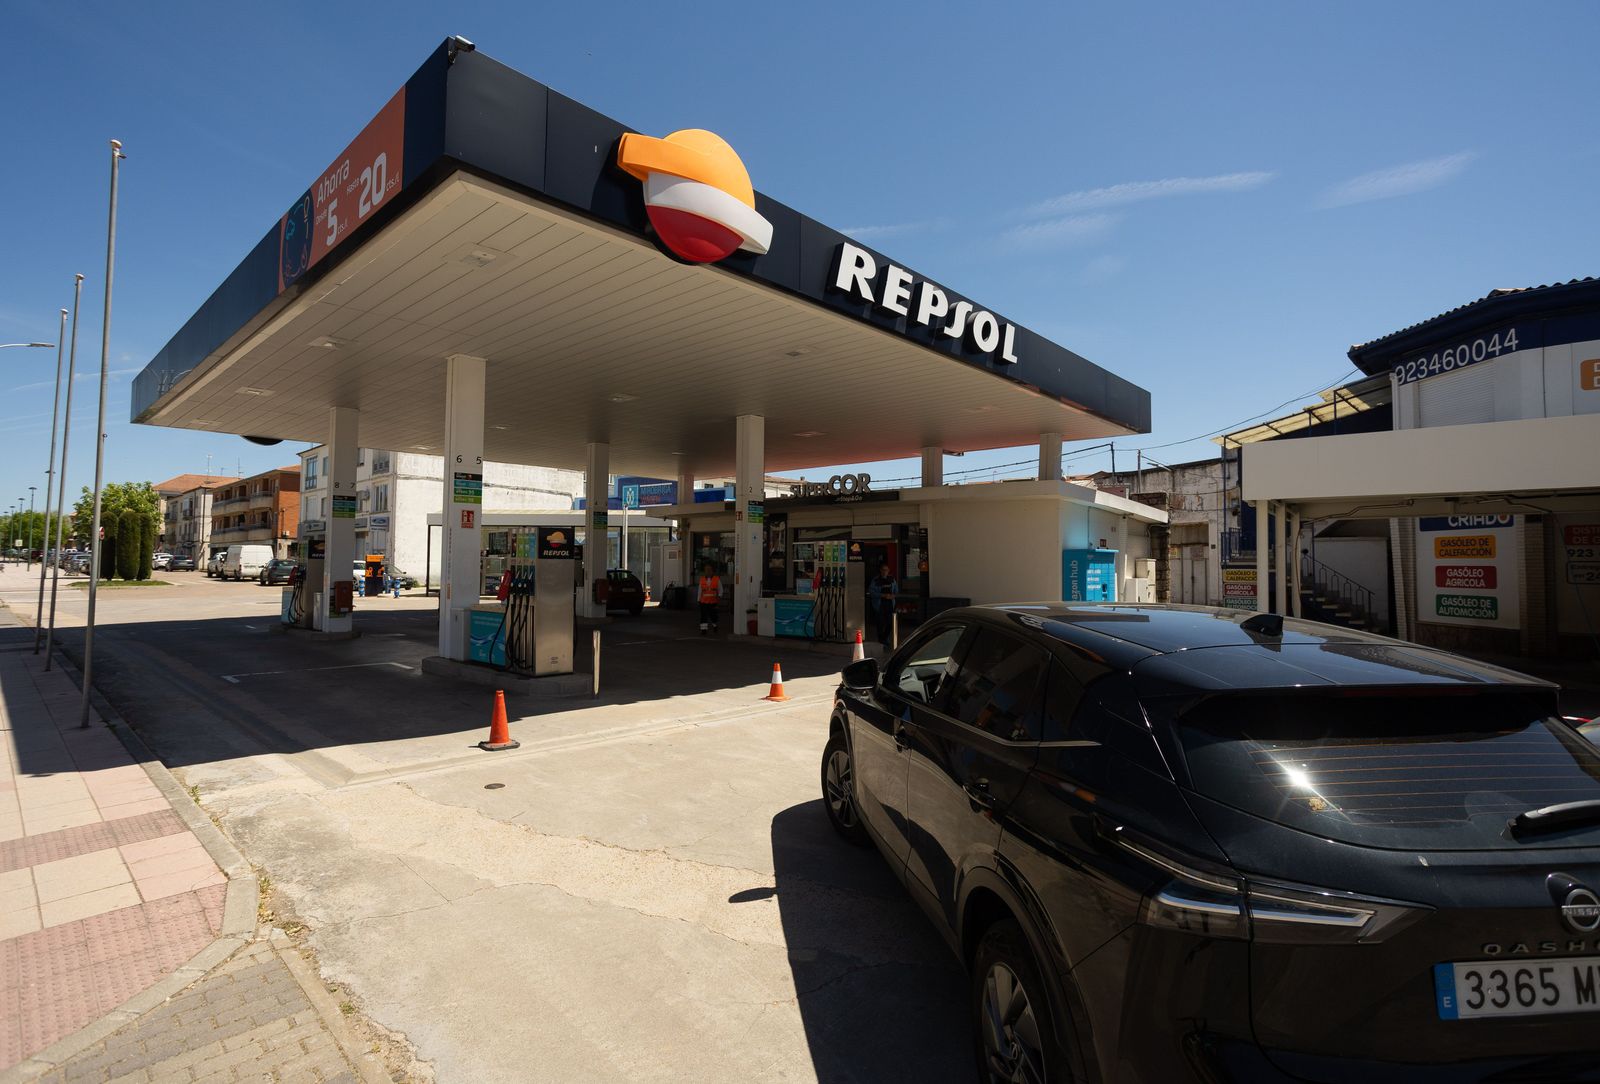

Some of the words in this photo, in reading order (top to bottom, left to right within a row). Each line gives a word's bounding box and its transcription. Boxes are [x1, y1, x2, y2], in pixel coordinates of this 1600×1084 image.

[316, 159, 350, 208] Ahorra
[358, 151, 387, 219] 20
[326, 198, 338, 247] 5
[835, 241, 1018, 364] REPSOL
[1395, 328, 1519, 385] 923460044
[456, 454, 463, 464] 6
[475, 456, 482, 465] 5
[334, 481, 340, 489] 8
[1447, 514, 1510, 528] CRIADO
[1440, 537, 1475, 547] GASÓLEO
[1478, 537, 1489, 547] DE
[1572, 536, 1590, 544] DE
[543, 549, 570, 557] REPSOL
[1567, 548, 1594, 558] 923
[1069, 560, 1079, 578] hub
[1446, 567, 1485, 578] GASÓLEO
[1071, 581, 1079, 601] azon
[1440, 597, 1478, 608] GASÓLEO
[1480, 599, 1492, 608] DE
[1438, 606, 1496, 619] AUTOMOCIÓN
[1483, 940, 1600, 956] QASH
[1464, 967, 1560, 1010] 3365
[1573, 966, 1600, 1005] M
[1443, 996, 1452, 1008] E
